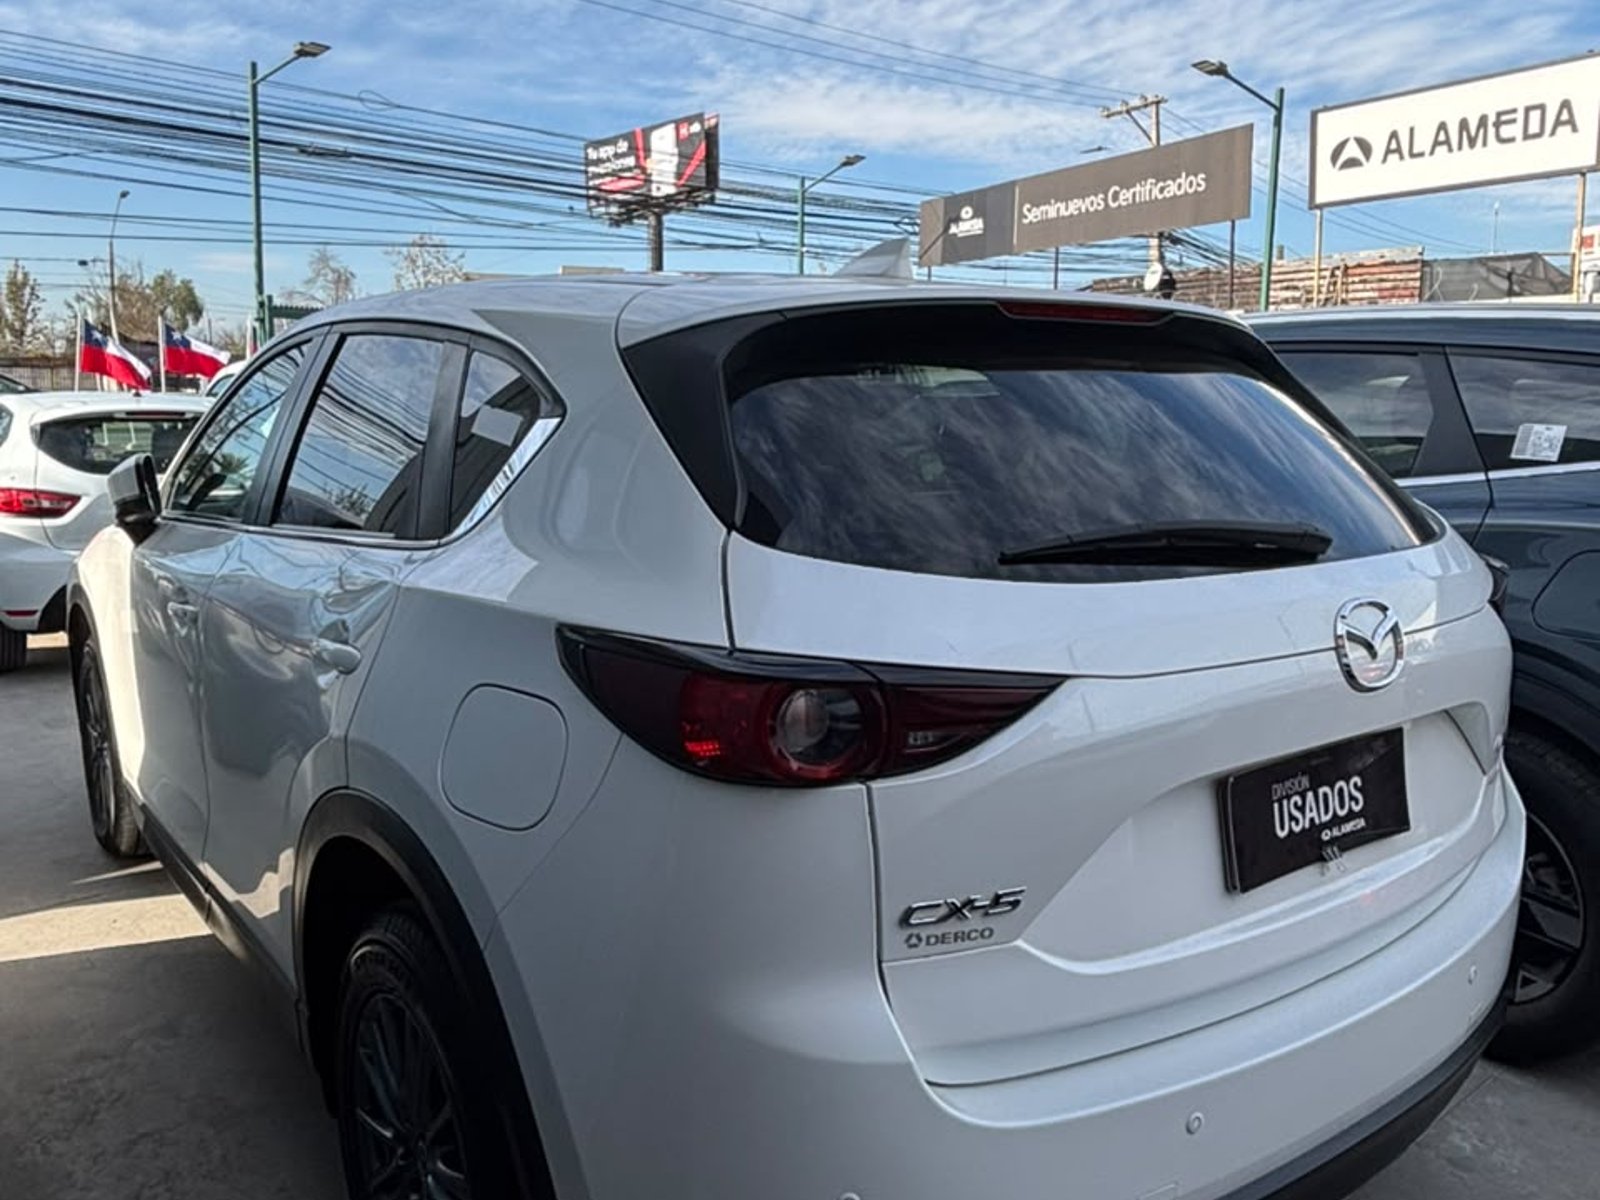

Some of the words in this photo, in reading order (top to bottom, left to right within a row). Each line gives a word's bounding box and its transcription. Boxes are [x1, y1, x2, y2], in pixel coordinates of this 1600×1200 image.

[1381, 98, 1579, 165] ALAMEDA
[1022, 192, 1105, 224] Seminuevos
[1107, 171, 1206, 208] Certificados
[1273, 775, 1364, 838] USADOS
[899, 886, 1027, 928] CX-5
[926, 927, 994, 946] DERCO
